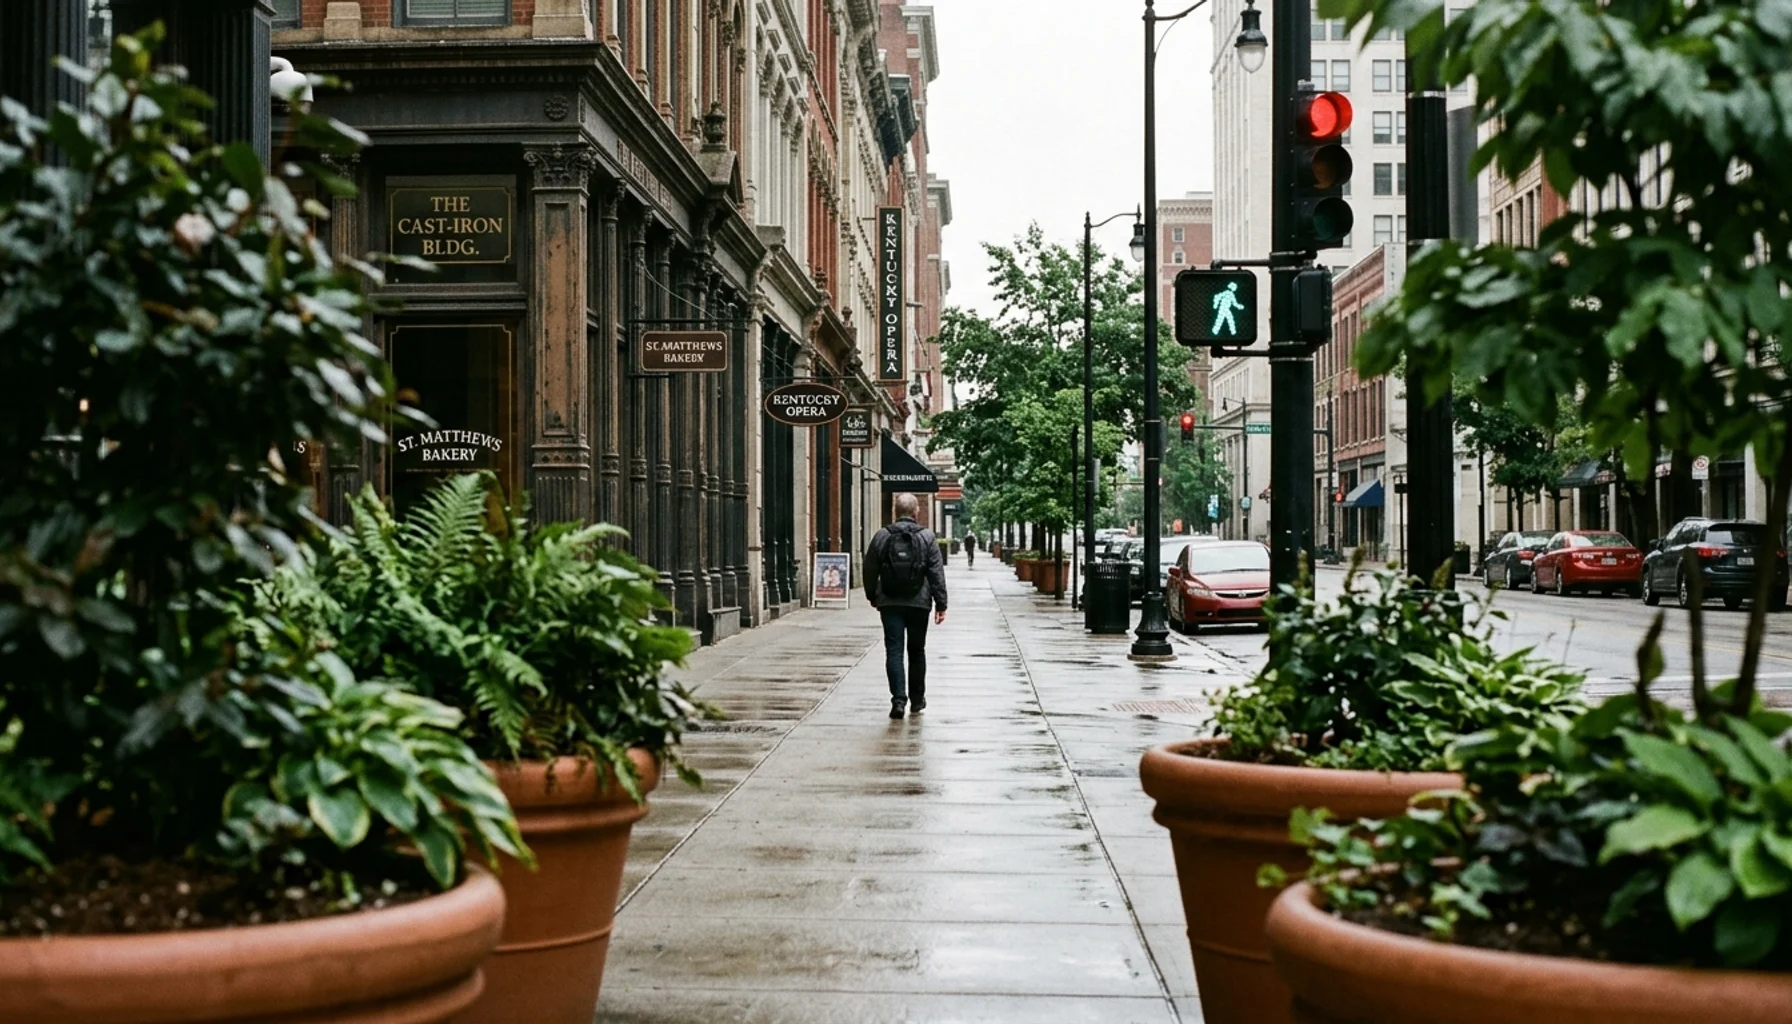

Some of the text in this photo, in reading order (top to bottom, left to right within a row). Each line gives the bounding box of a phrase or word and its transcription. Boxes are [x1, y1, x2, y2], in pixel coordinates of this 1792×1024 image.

[430, 196, 471, 212] THE
[398, 217, 503, 234] CAST-IRON
[422, 239, 480, 255] BLDG.
[885, 213, 898, 373] KENTUCKY OPERA
[785, 406, 827, 417] OPERA
[397, 436, 419, 452] ST.
[422, 448, 478, 461] BAKERY
